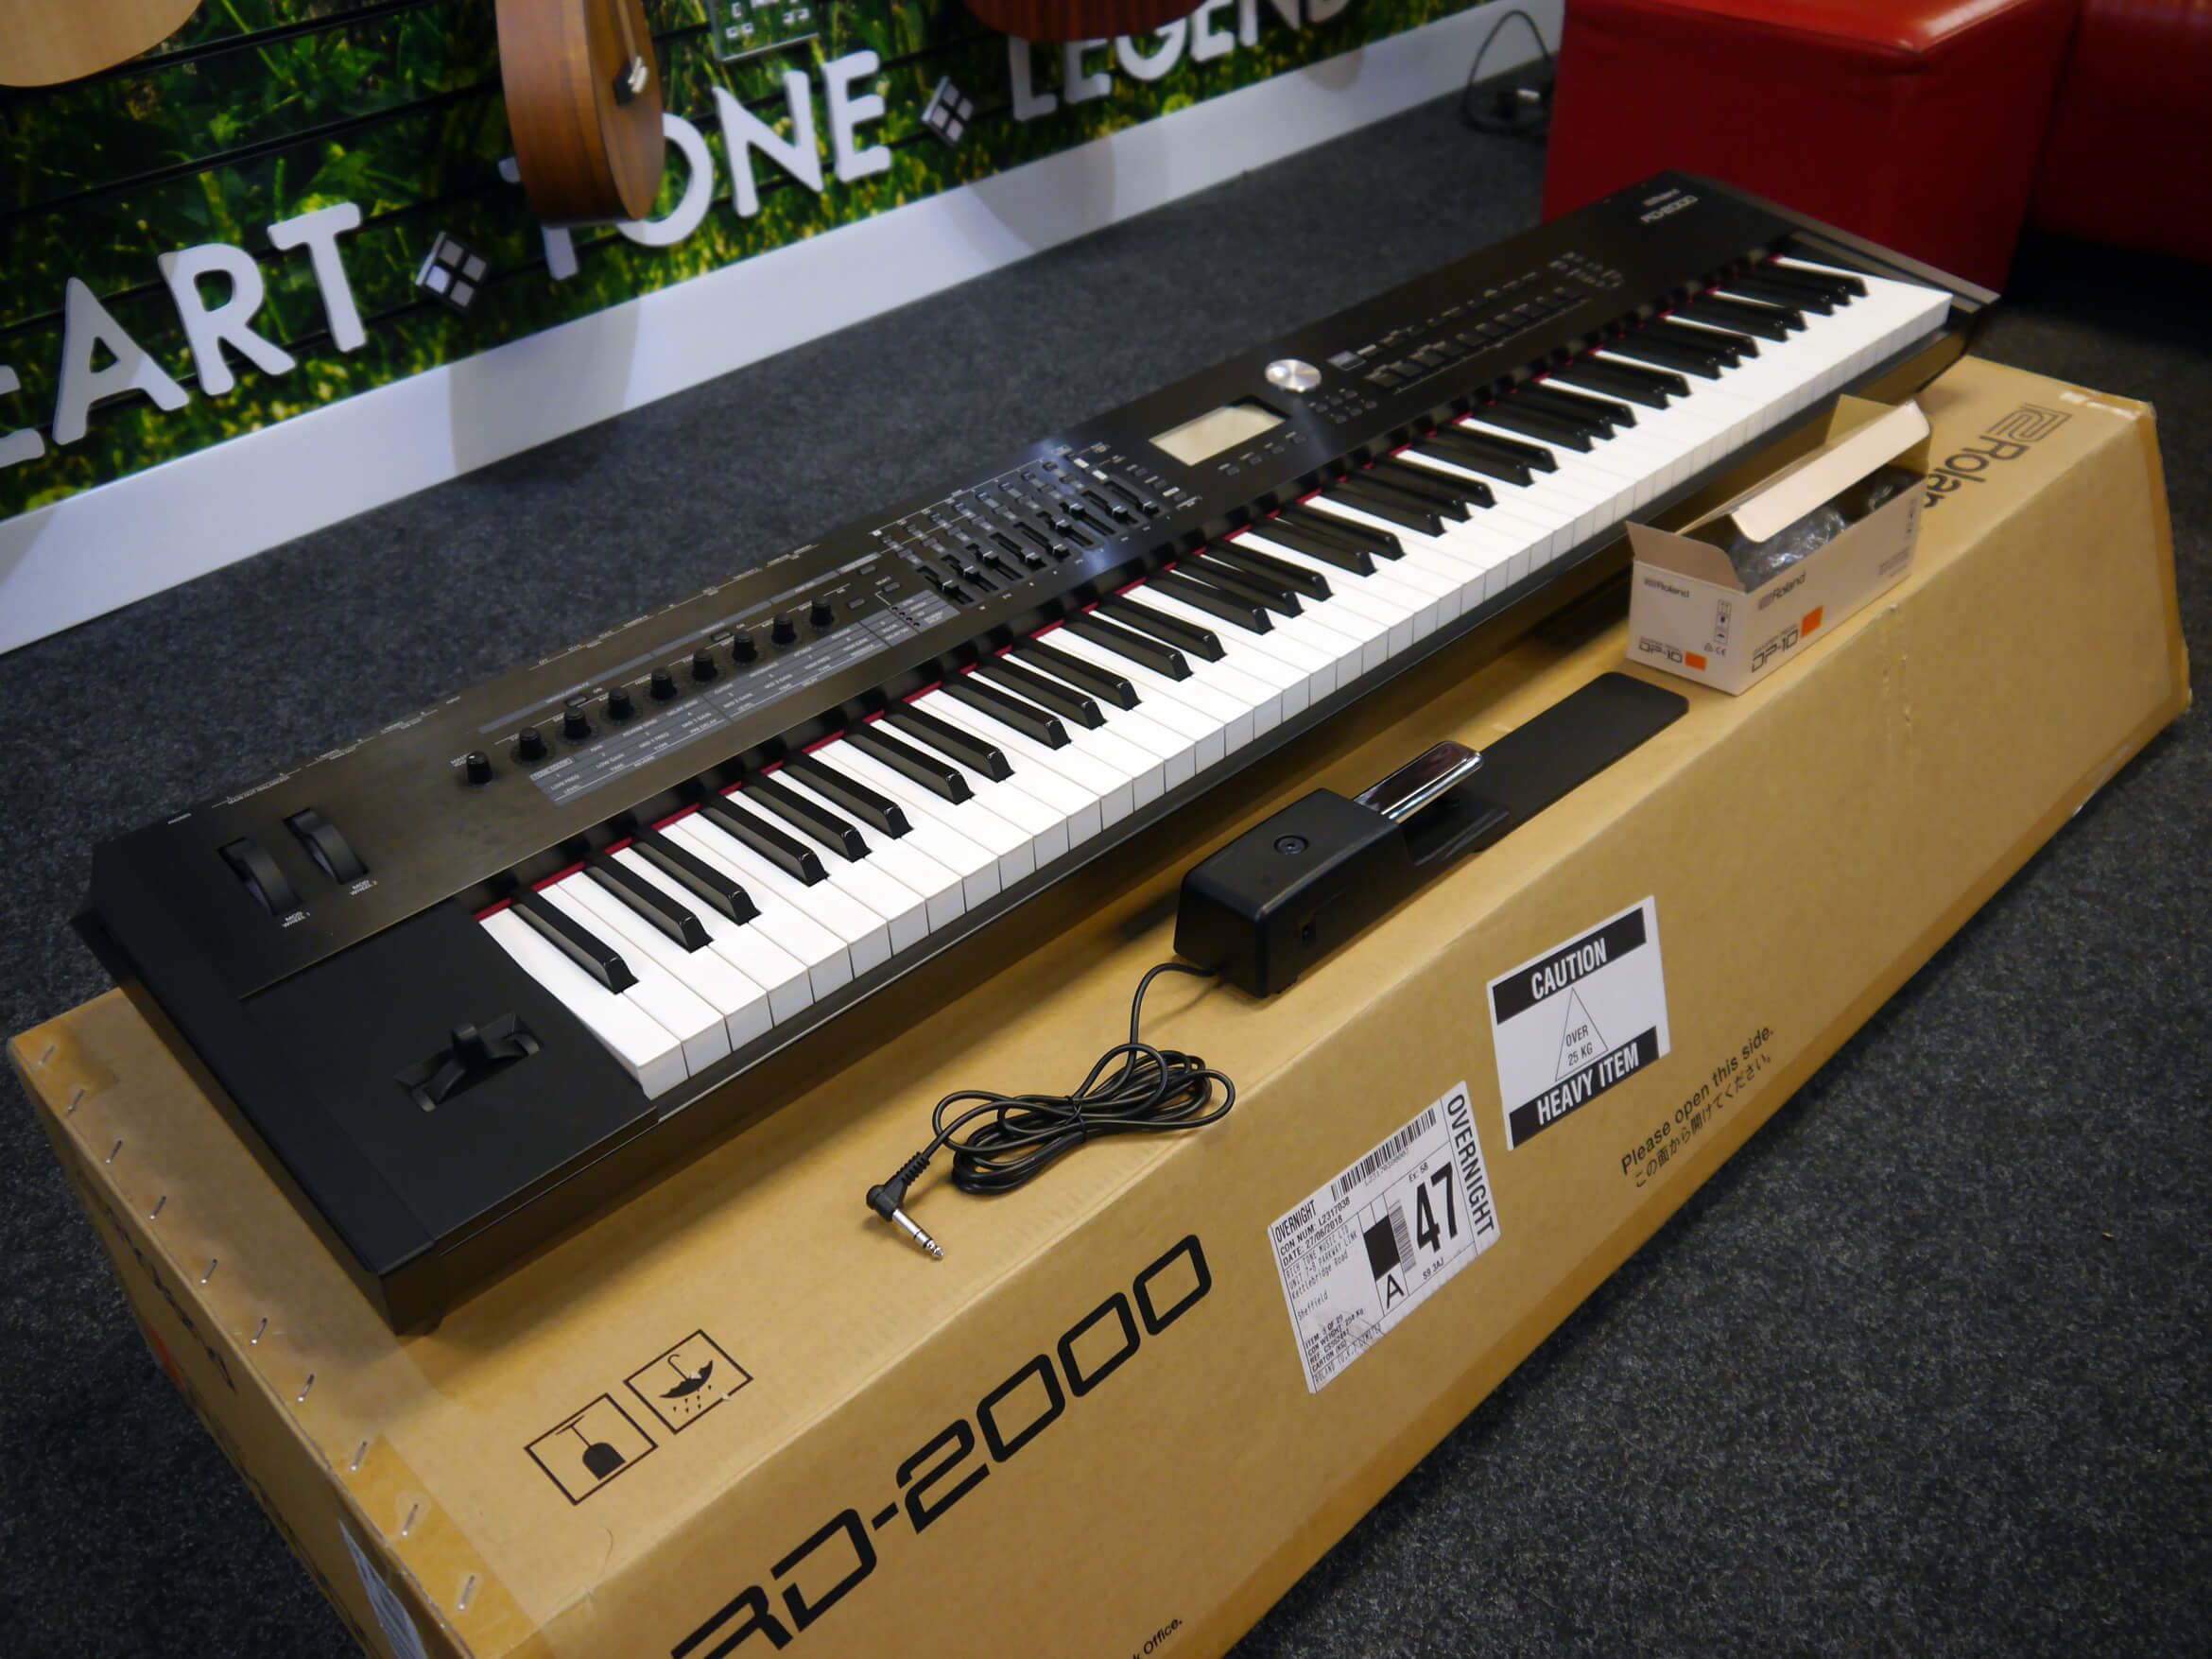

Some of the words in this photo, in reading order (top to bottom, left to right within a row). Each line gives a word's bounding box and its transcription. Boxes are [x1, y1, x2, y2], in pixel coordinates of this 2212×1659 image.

[1656, 582, 1690, 598] Roland
[1771, 570, 1807, 600] Roland
[1639, 641, 1683, 664] DP-10
[1752, 629, 1799, 673] DP-10
[1531, 937, 1608, 1000] CAUTION
[1565, 1024, 1589, 1047] OVER
[1567, 1048, 1580, 1067] 25
[1581, 1042, 1594, 1058] KG
[1536, 1069, 1595, 1126] HEAVY
[1599, 1042, 1639, 1087] ITEM
[1621, 1121, 1671, 1175] Please
[1674, 1083, 1710, 1124] open
[1712, 1056, 1739, 1088] this
[1741, 1025, 1774, 1061] side.
[1447, 1093, 1495, 1238] OVERNIGHT
[1274, 1199, 1317, 1244] OVERNIGHT
[1415, 1161, 1459, 1253] 47
[1280, 1237, 1296, 1256] CON
[1296, 1221, 1317, 1243] NUM:
[1283, 1243, 1305, 1267] DATE:
[1385, 1273, 1406, 1309] A
[670, 1234, 1213, 1659] RD-2000
